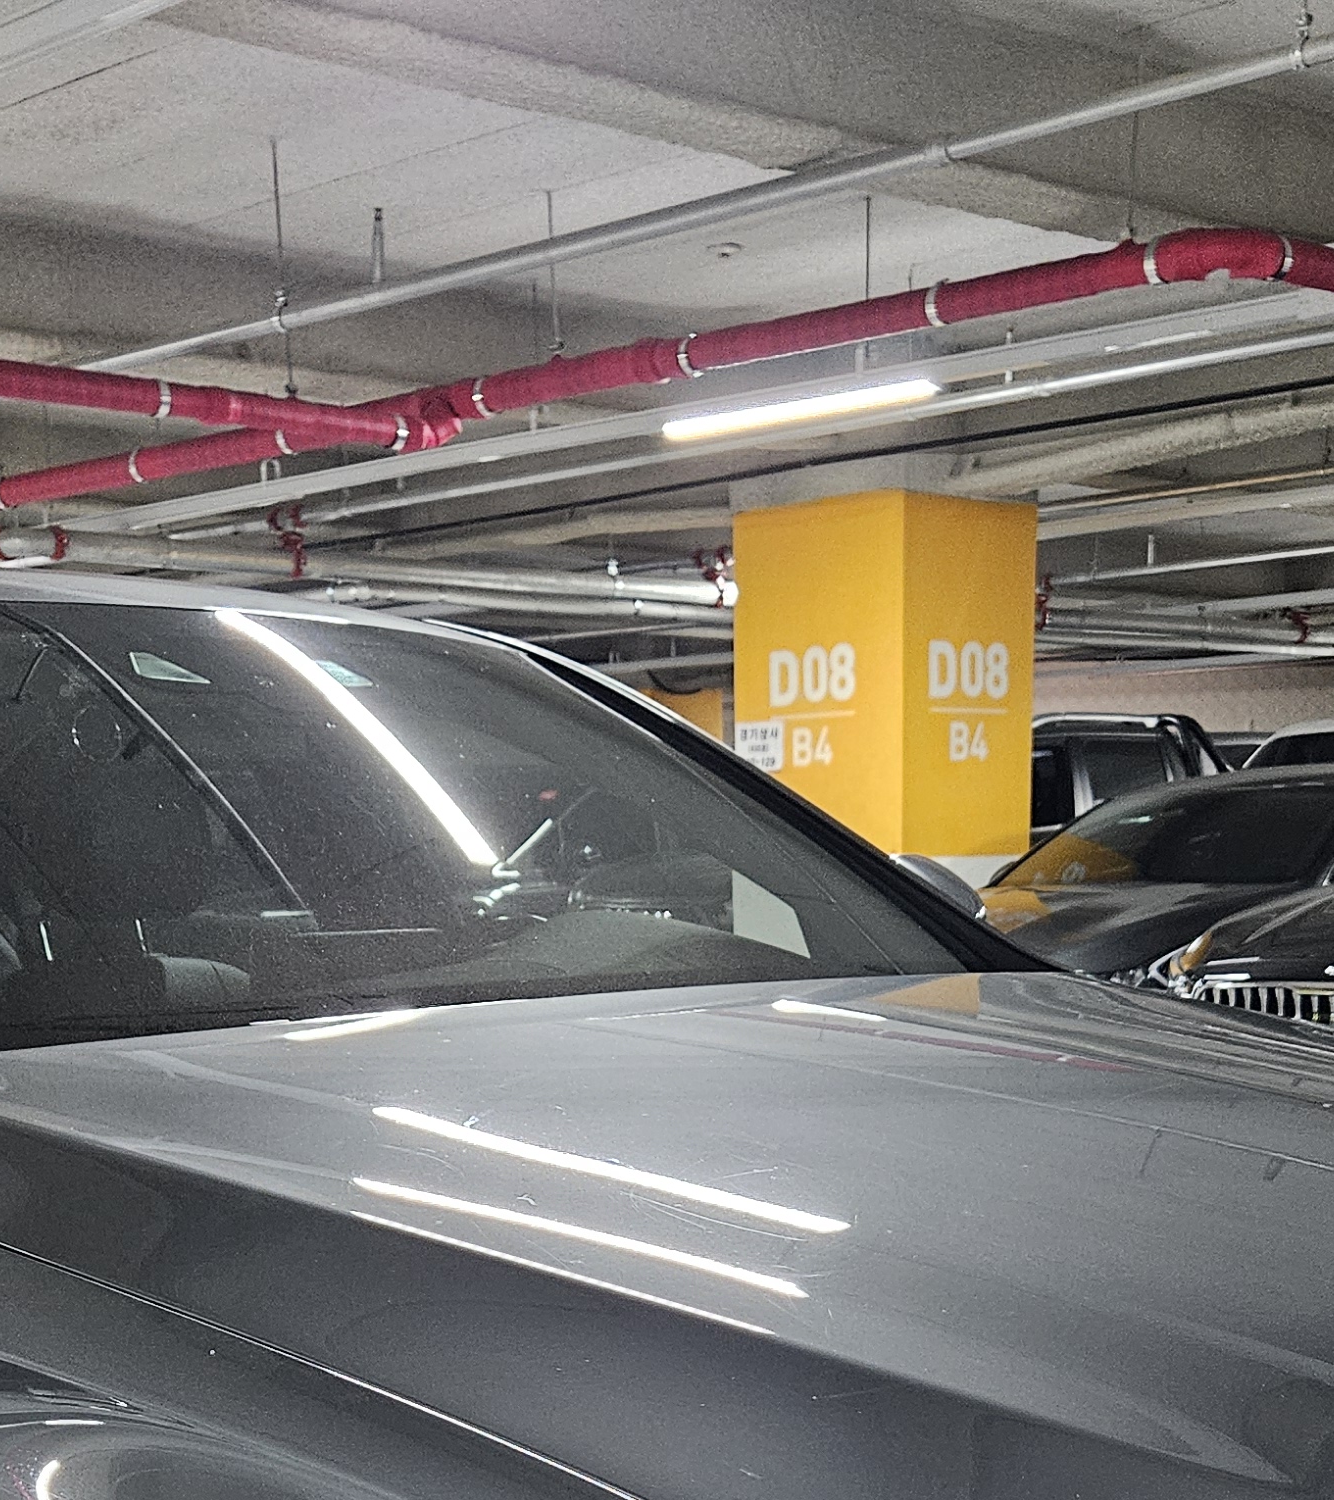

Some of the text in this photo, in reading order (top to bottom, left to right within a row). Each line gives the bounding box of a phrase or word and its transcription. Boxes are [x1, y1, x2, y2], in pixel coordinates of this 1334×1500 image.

[769, 642, 856, 707] D08
[928, 639, 1010, 699] D08
[792, 726, 833, 767] B4
[949, 721, 989, 762] B4
